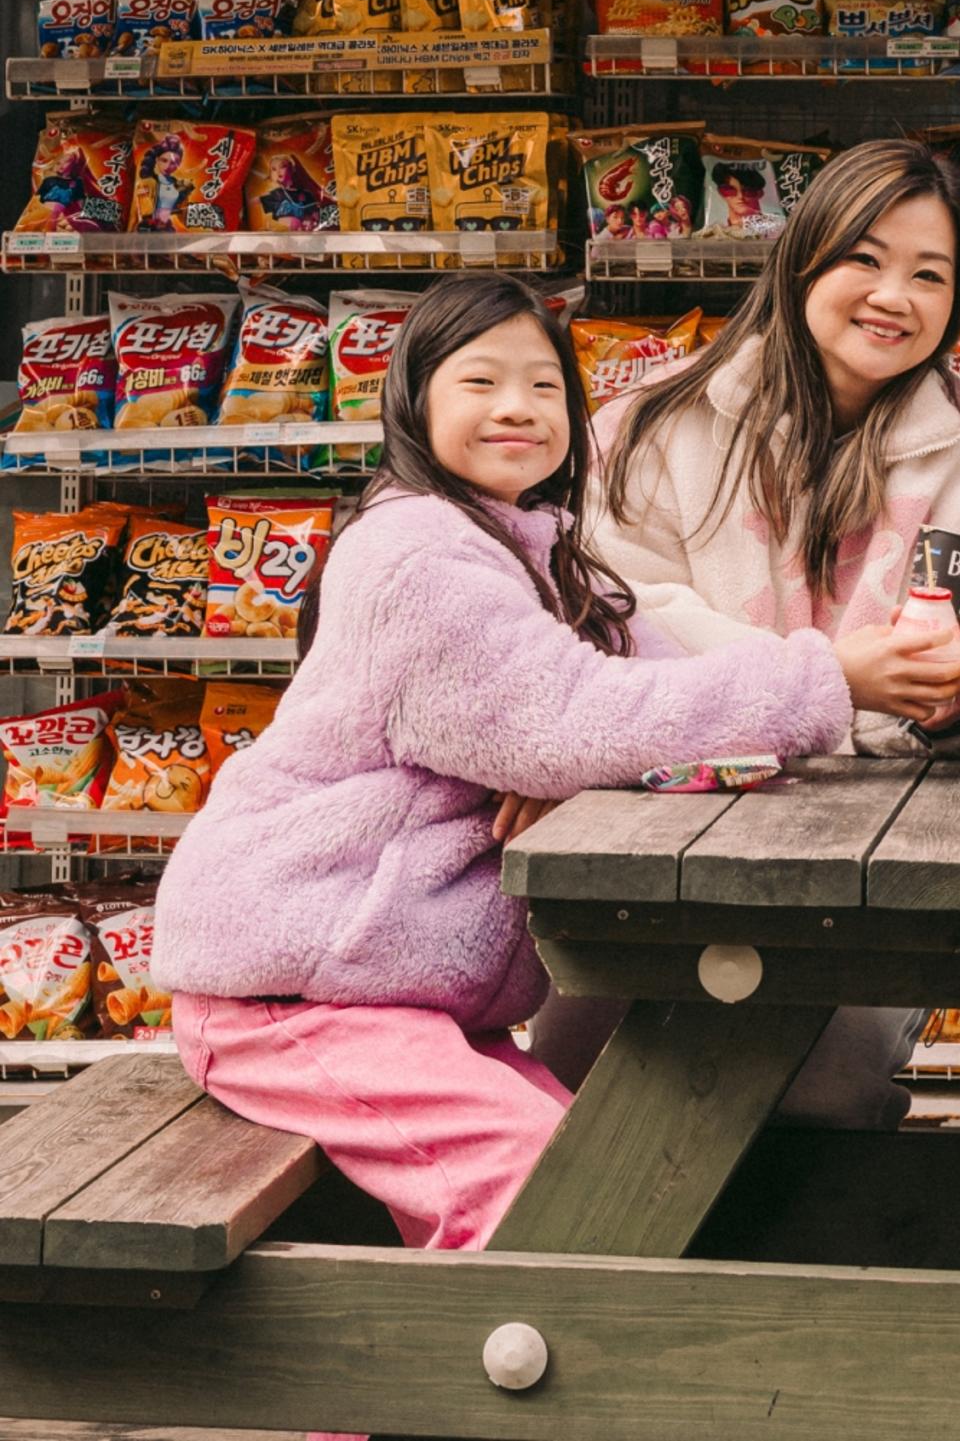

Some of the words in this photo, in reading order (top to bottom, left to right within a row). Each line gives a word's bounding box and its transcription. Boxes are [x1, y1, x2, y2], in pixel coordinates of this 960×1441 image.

[202, 45, 254, 54] SK하이닉스
[378, 44, 417, 53] 하이닉스
[415, 54, 439, 63] HBM
[441, 53, 470, 63] Chips
[347, 125, 358, 133] SK
[200, 136, 234, 200] 새우깡
[360, 141, 411, 171] HBM
[370, 159, 427, 186] Chips
[463, 160, 520, 185] Chips
[22, 329, 111, 363] 포카칩
[120, 322, 218, 353] 포카칩
[12, 534, 104, 579] Cheetos
[129, 533, 208, 570] Cheeto
[151, 562, 208, 582] 치토
[5, 716, 96, 747] 꼬깔콘
[115, 725, 206, 759] 감자깡
[105, 901, 132, 911] LOTTE
[136, 1029, 155, 1040] 2+1
